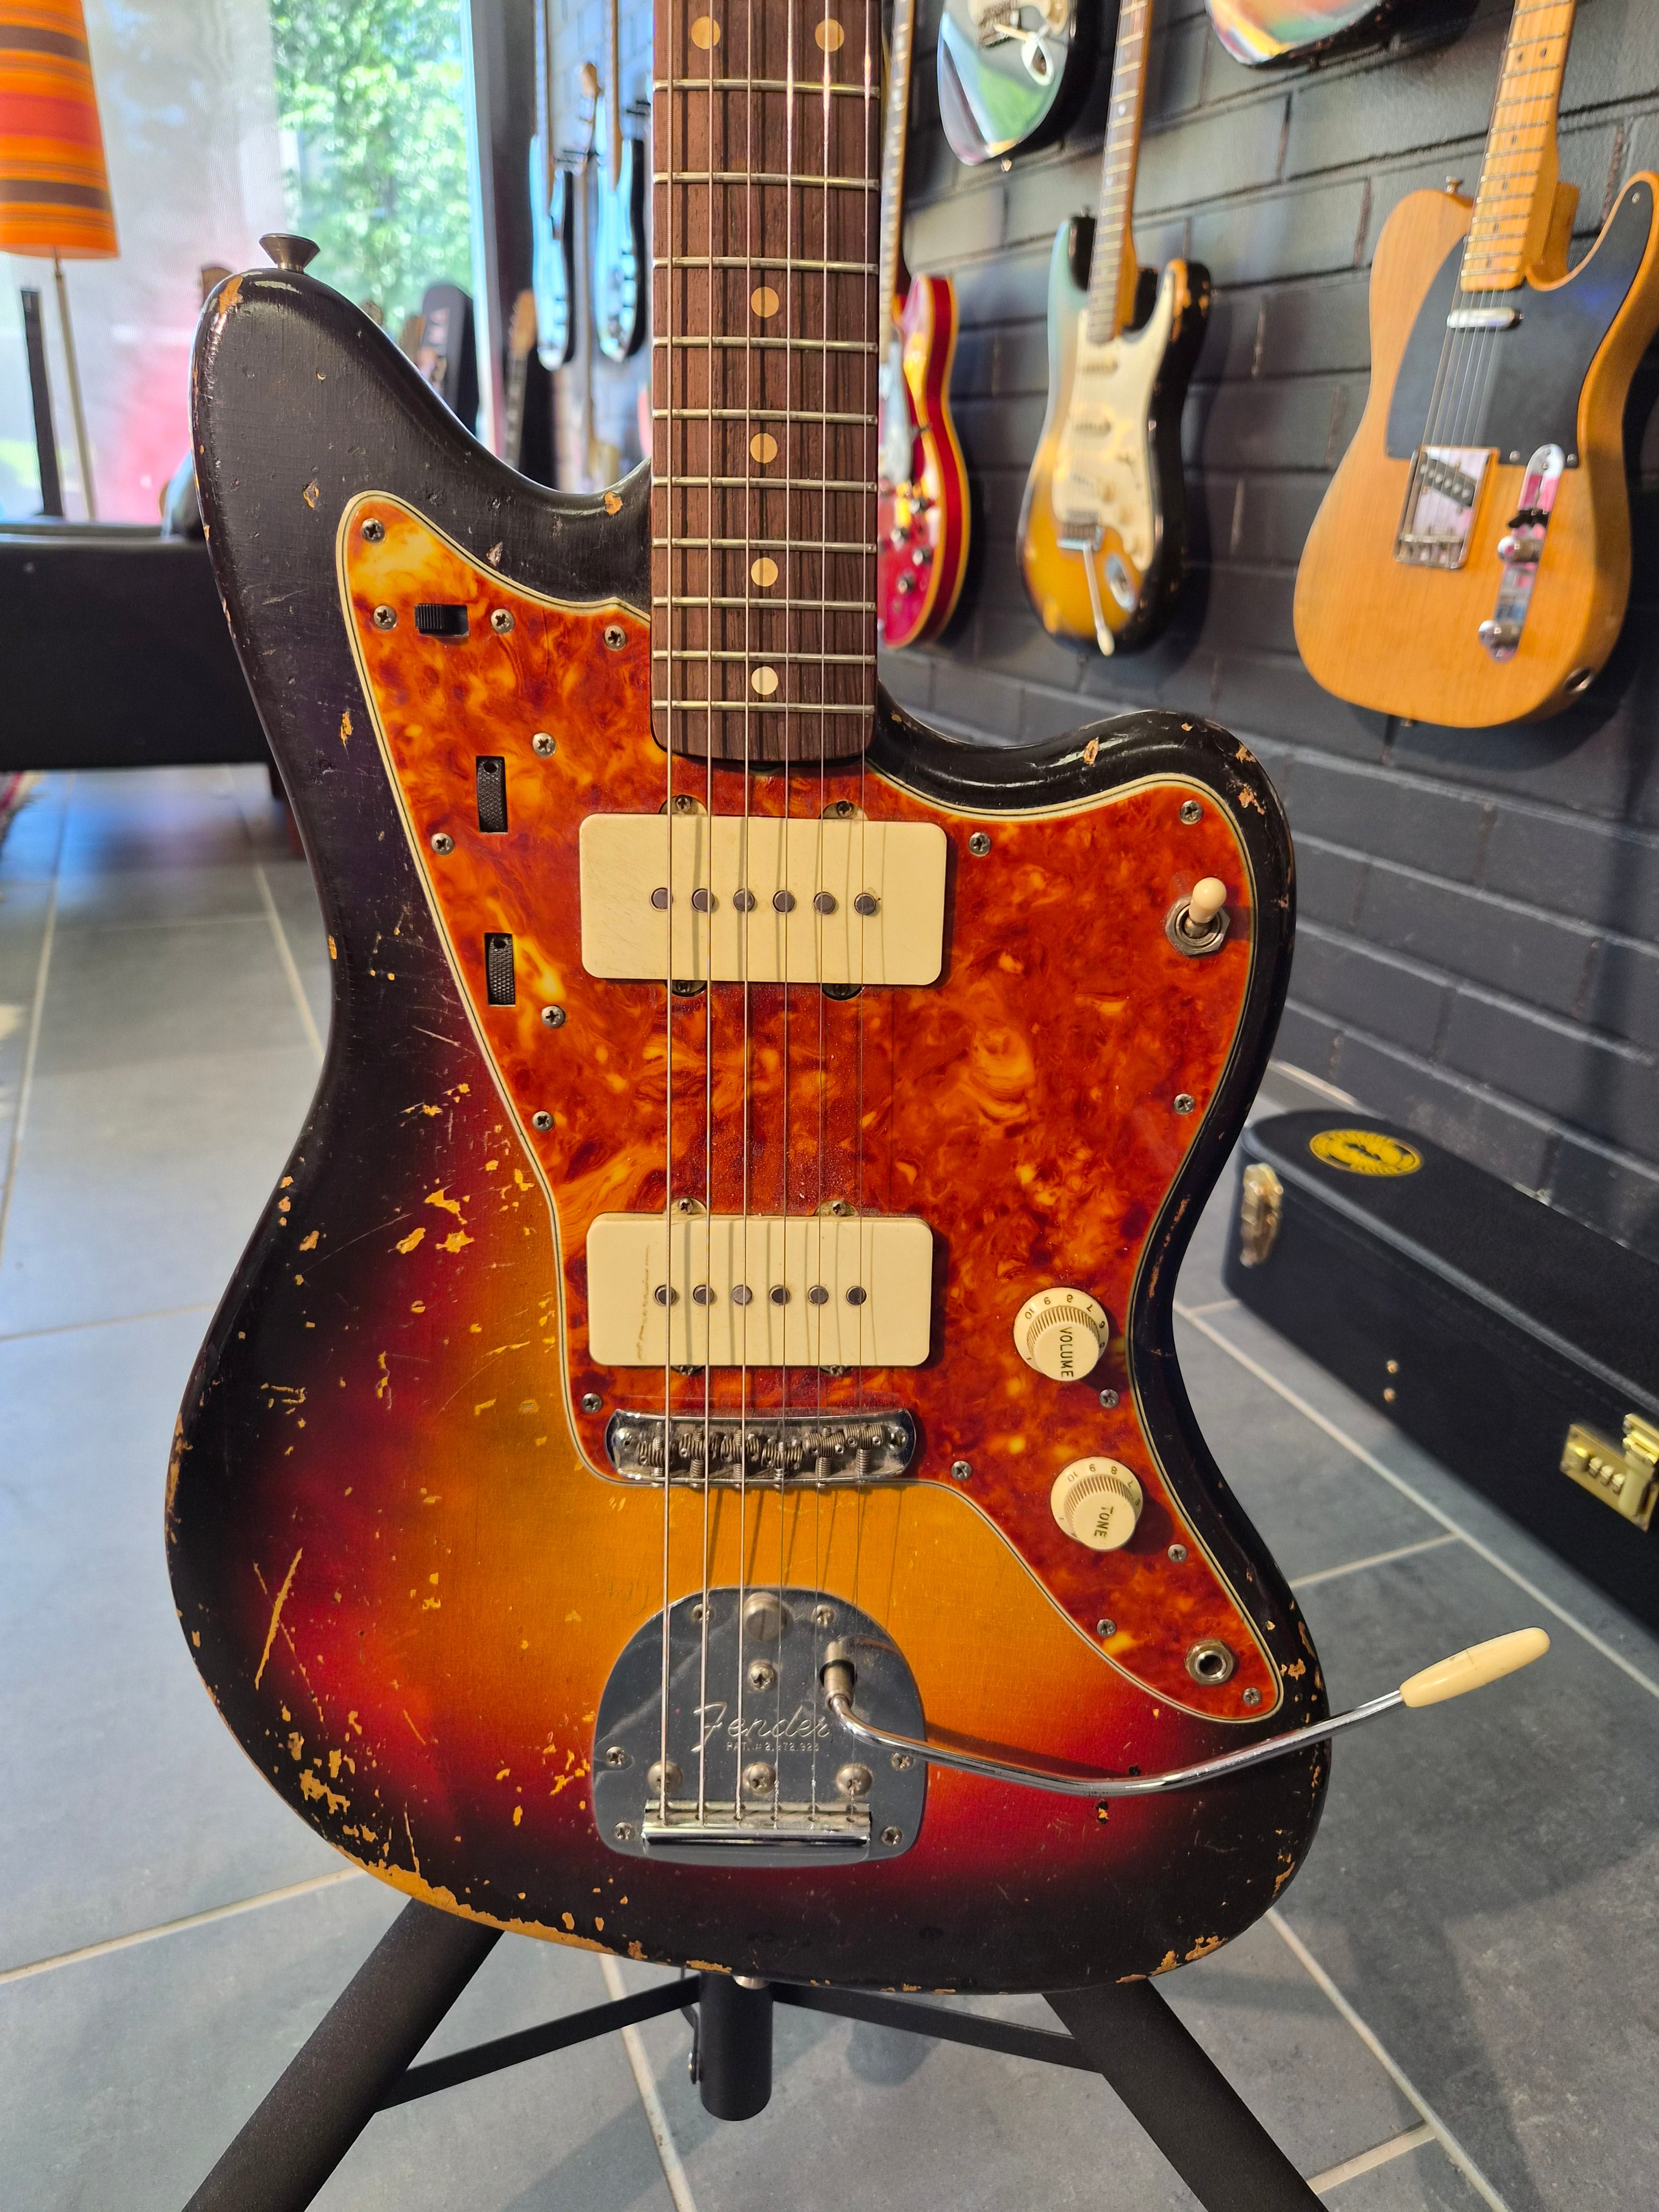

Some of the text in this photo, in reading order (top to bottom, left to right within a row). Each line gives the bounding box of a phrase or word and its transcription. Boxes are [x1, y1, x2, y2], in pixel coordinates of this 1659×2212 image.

[1087, 1303, 1093, 1312] 7
[1060, 1326, 1074, 1378] VOLUME
[1110, 1466, 1118, 1475] 8
[1093, 1506, 1114, 1537] TONE
[691, 1701, 830, 1752] Fender
